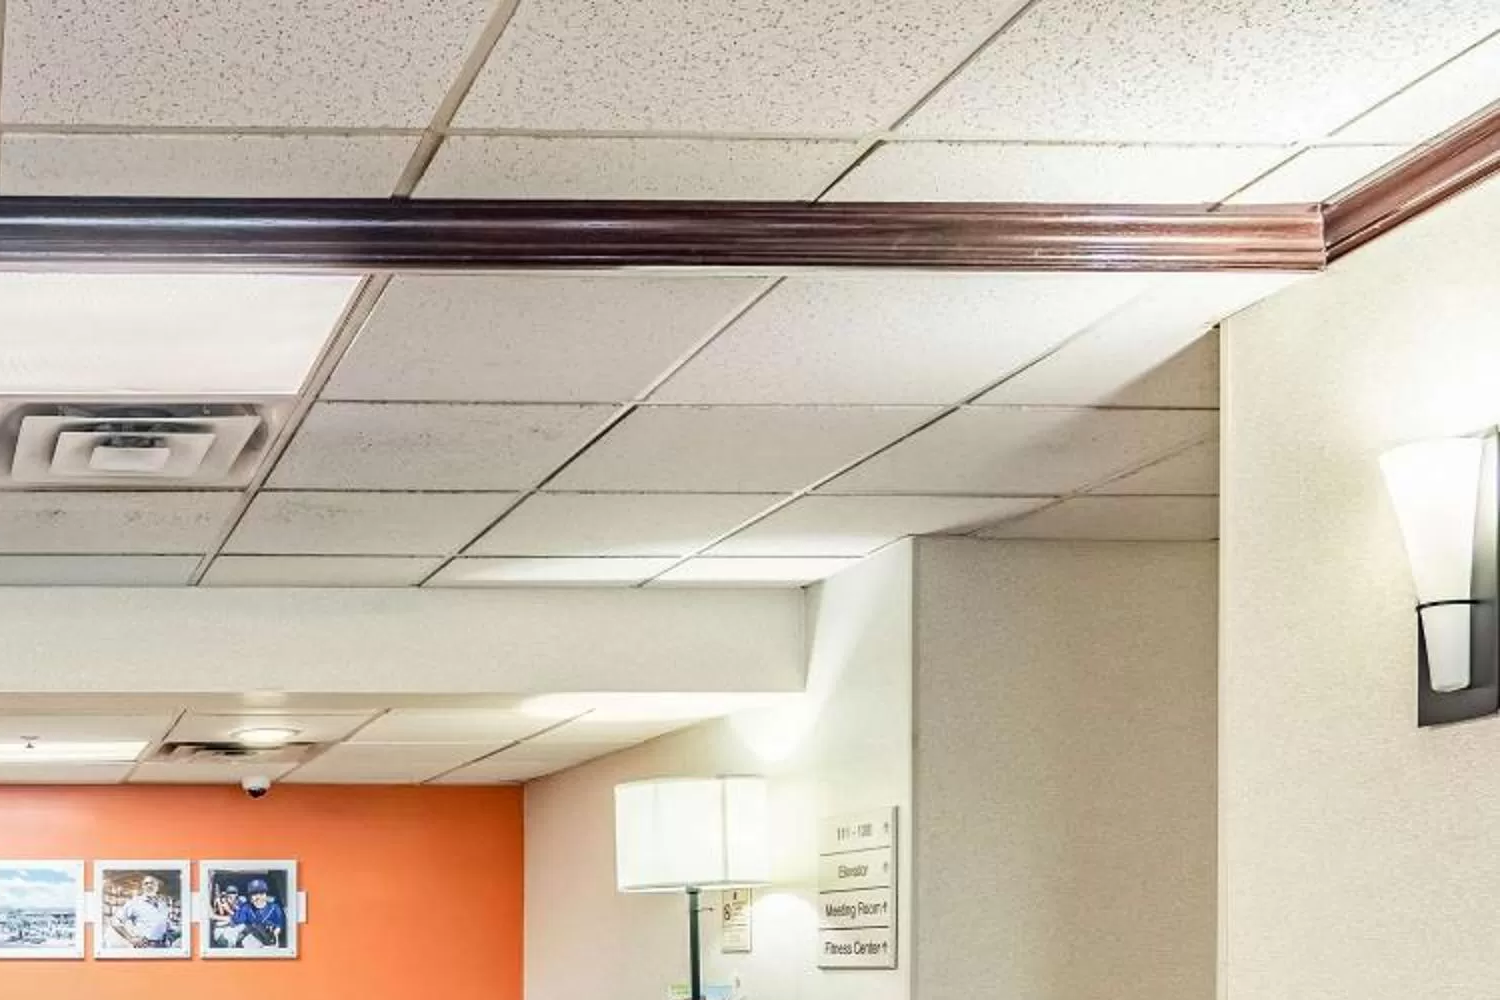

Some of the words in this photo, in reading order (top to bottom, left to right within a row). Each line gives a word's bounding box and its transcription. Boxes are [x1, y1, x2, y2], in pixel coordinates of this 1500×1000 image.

[825, 903, 855, 919] Meeting
[858, 901, 882, 916] Room
[824, 941, 852, 955] Fitness
[853, 940, 880, 955] Center
